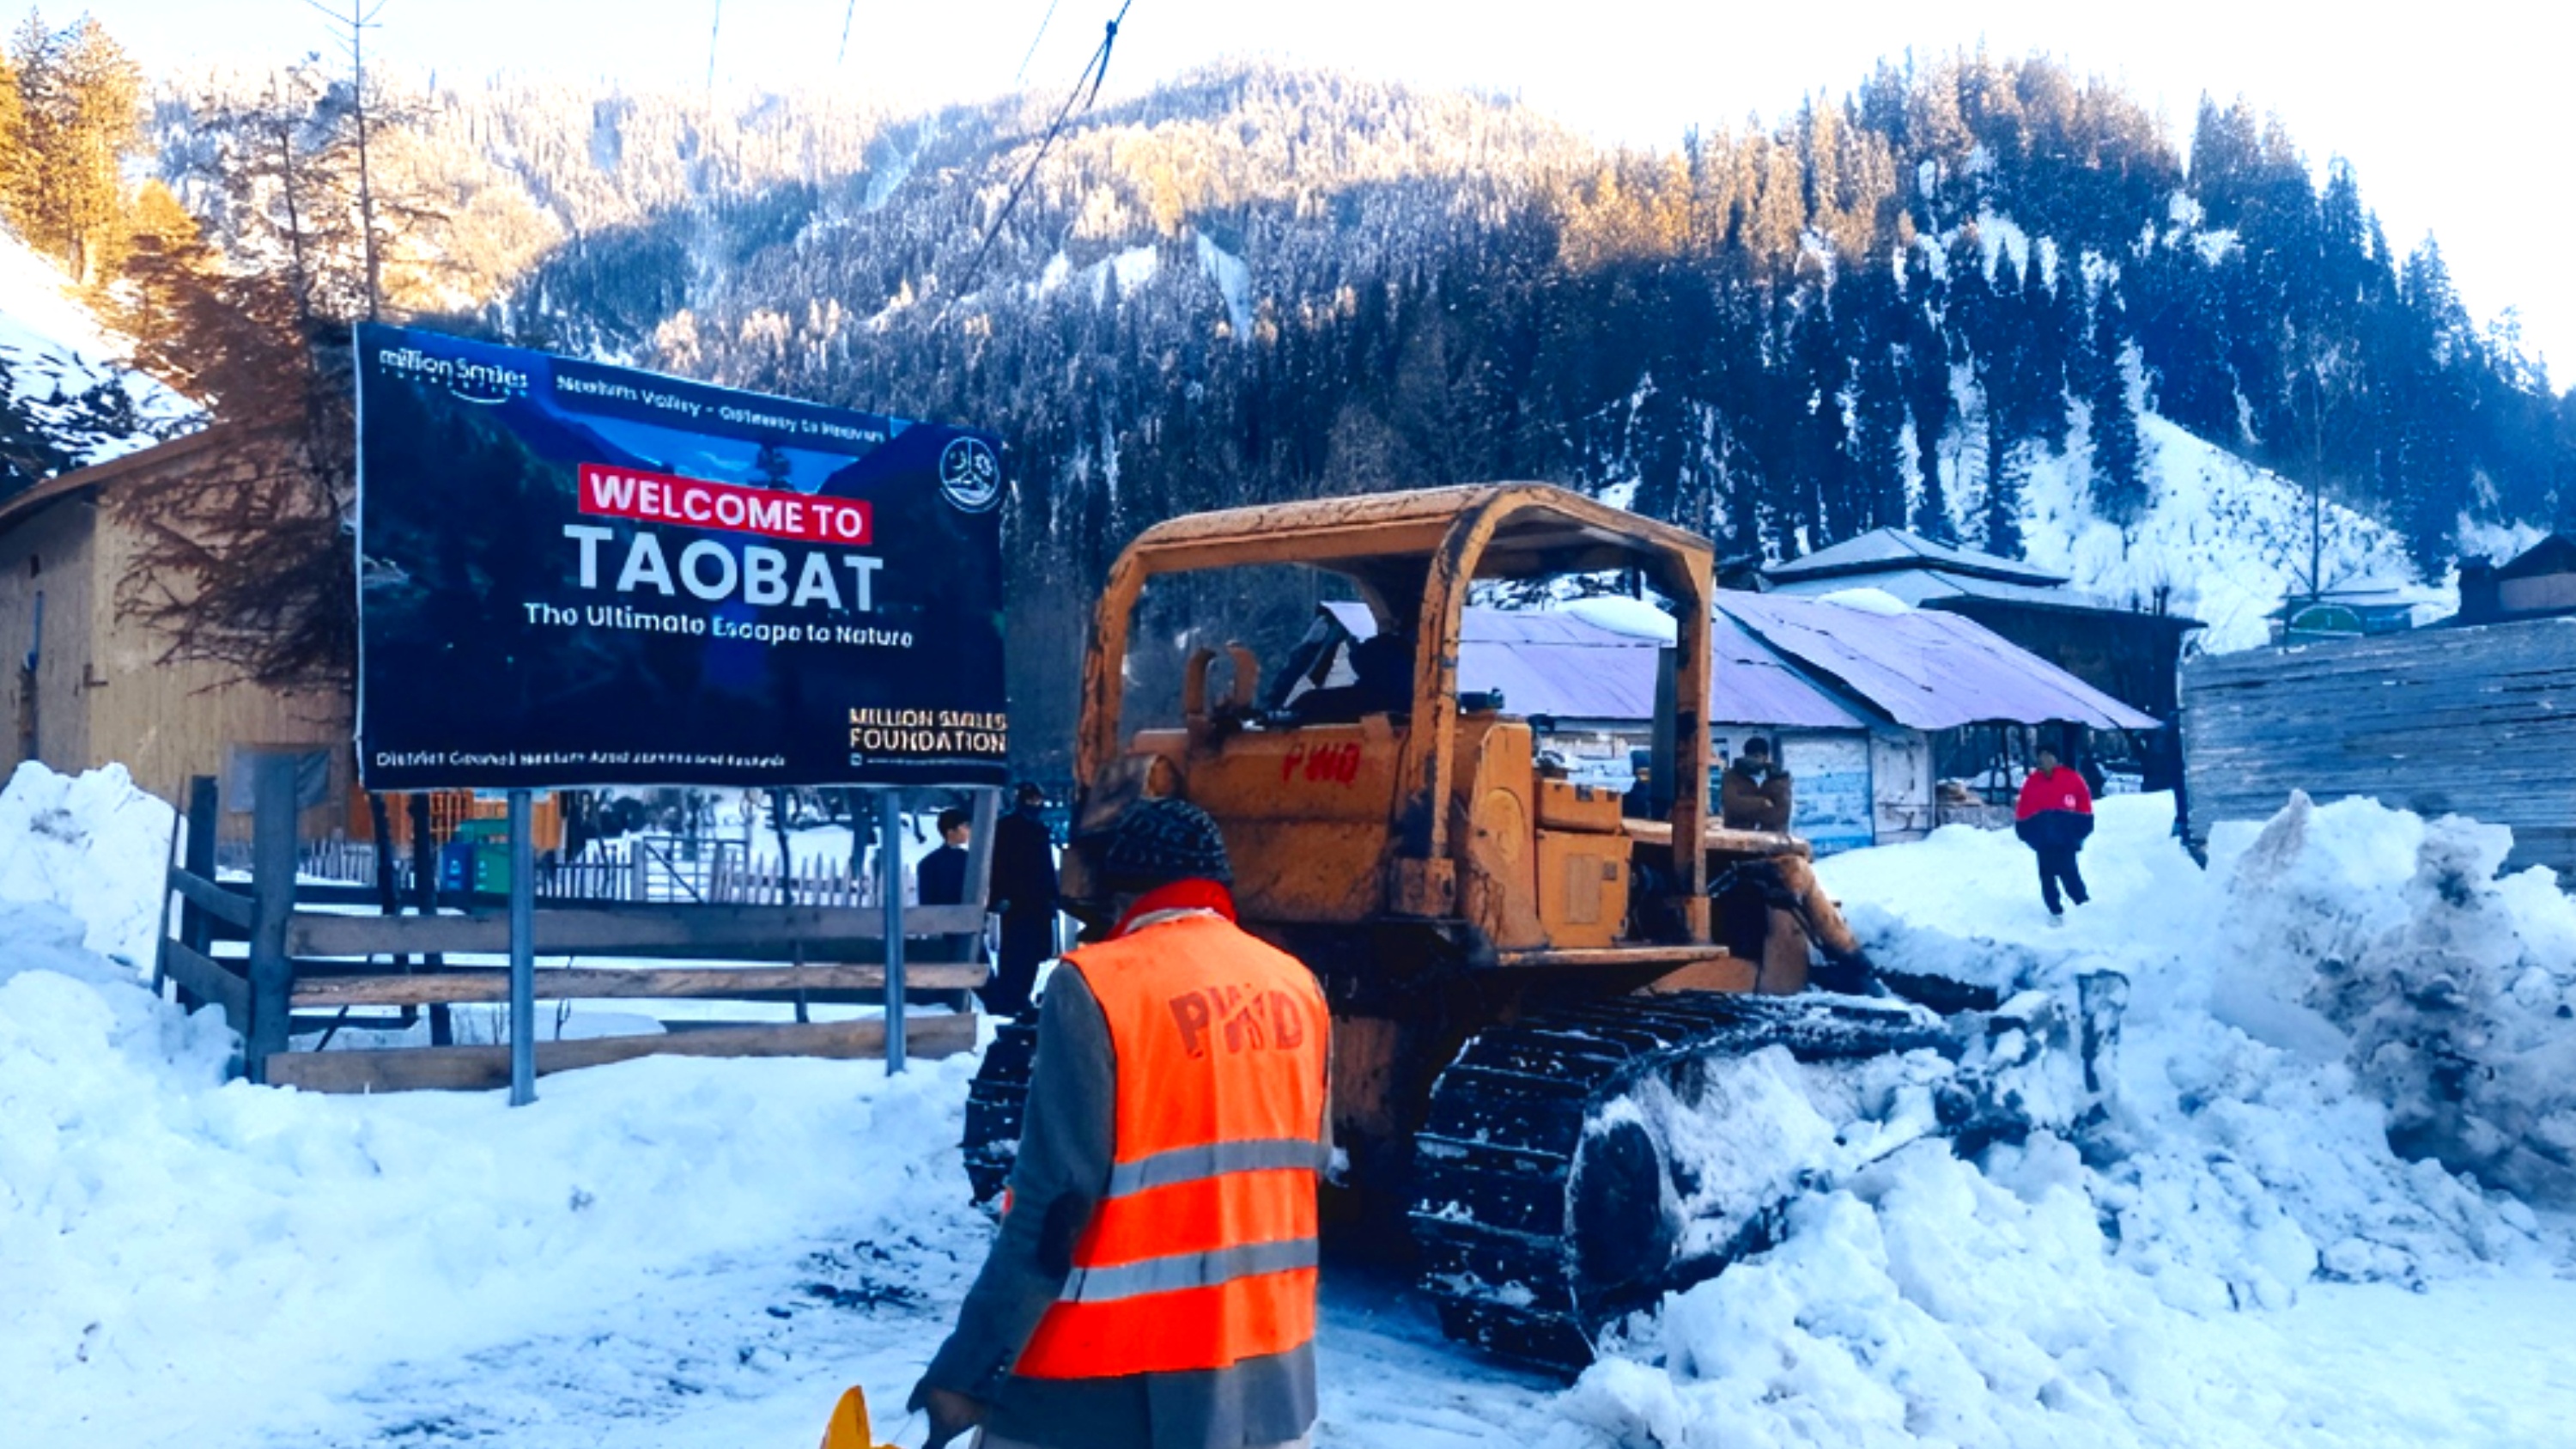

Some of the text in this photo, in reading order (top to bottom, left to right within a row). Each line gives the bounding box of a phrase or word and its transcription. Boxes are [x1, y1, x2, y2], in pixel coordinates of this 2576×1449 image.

[590, 472, 863, 538] WELCOME TO
[563, 524, 884, 612] TAOBAT
[524, 602, 913, 648] The Ultimate Escape to Nature
[849, 708, 934, 727] MILLION
[850, 728, 1007, 752] FOUNDATION
[1281, 742, 1360, 786] PWD
[1169, 985, 1303, 1060] PWD
